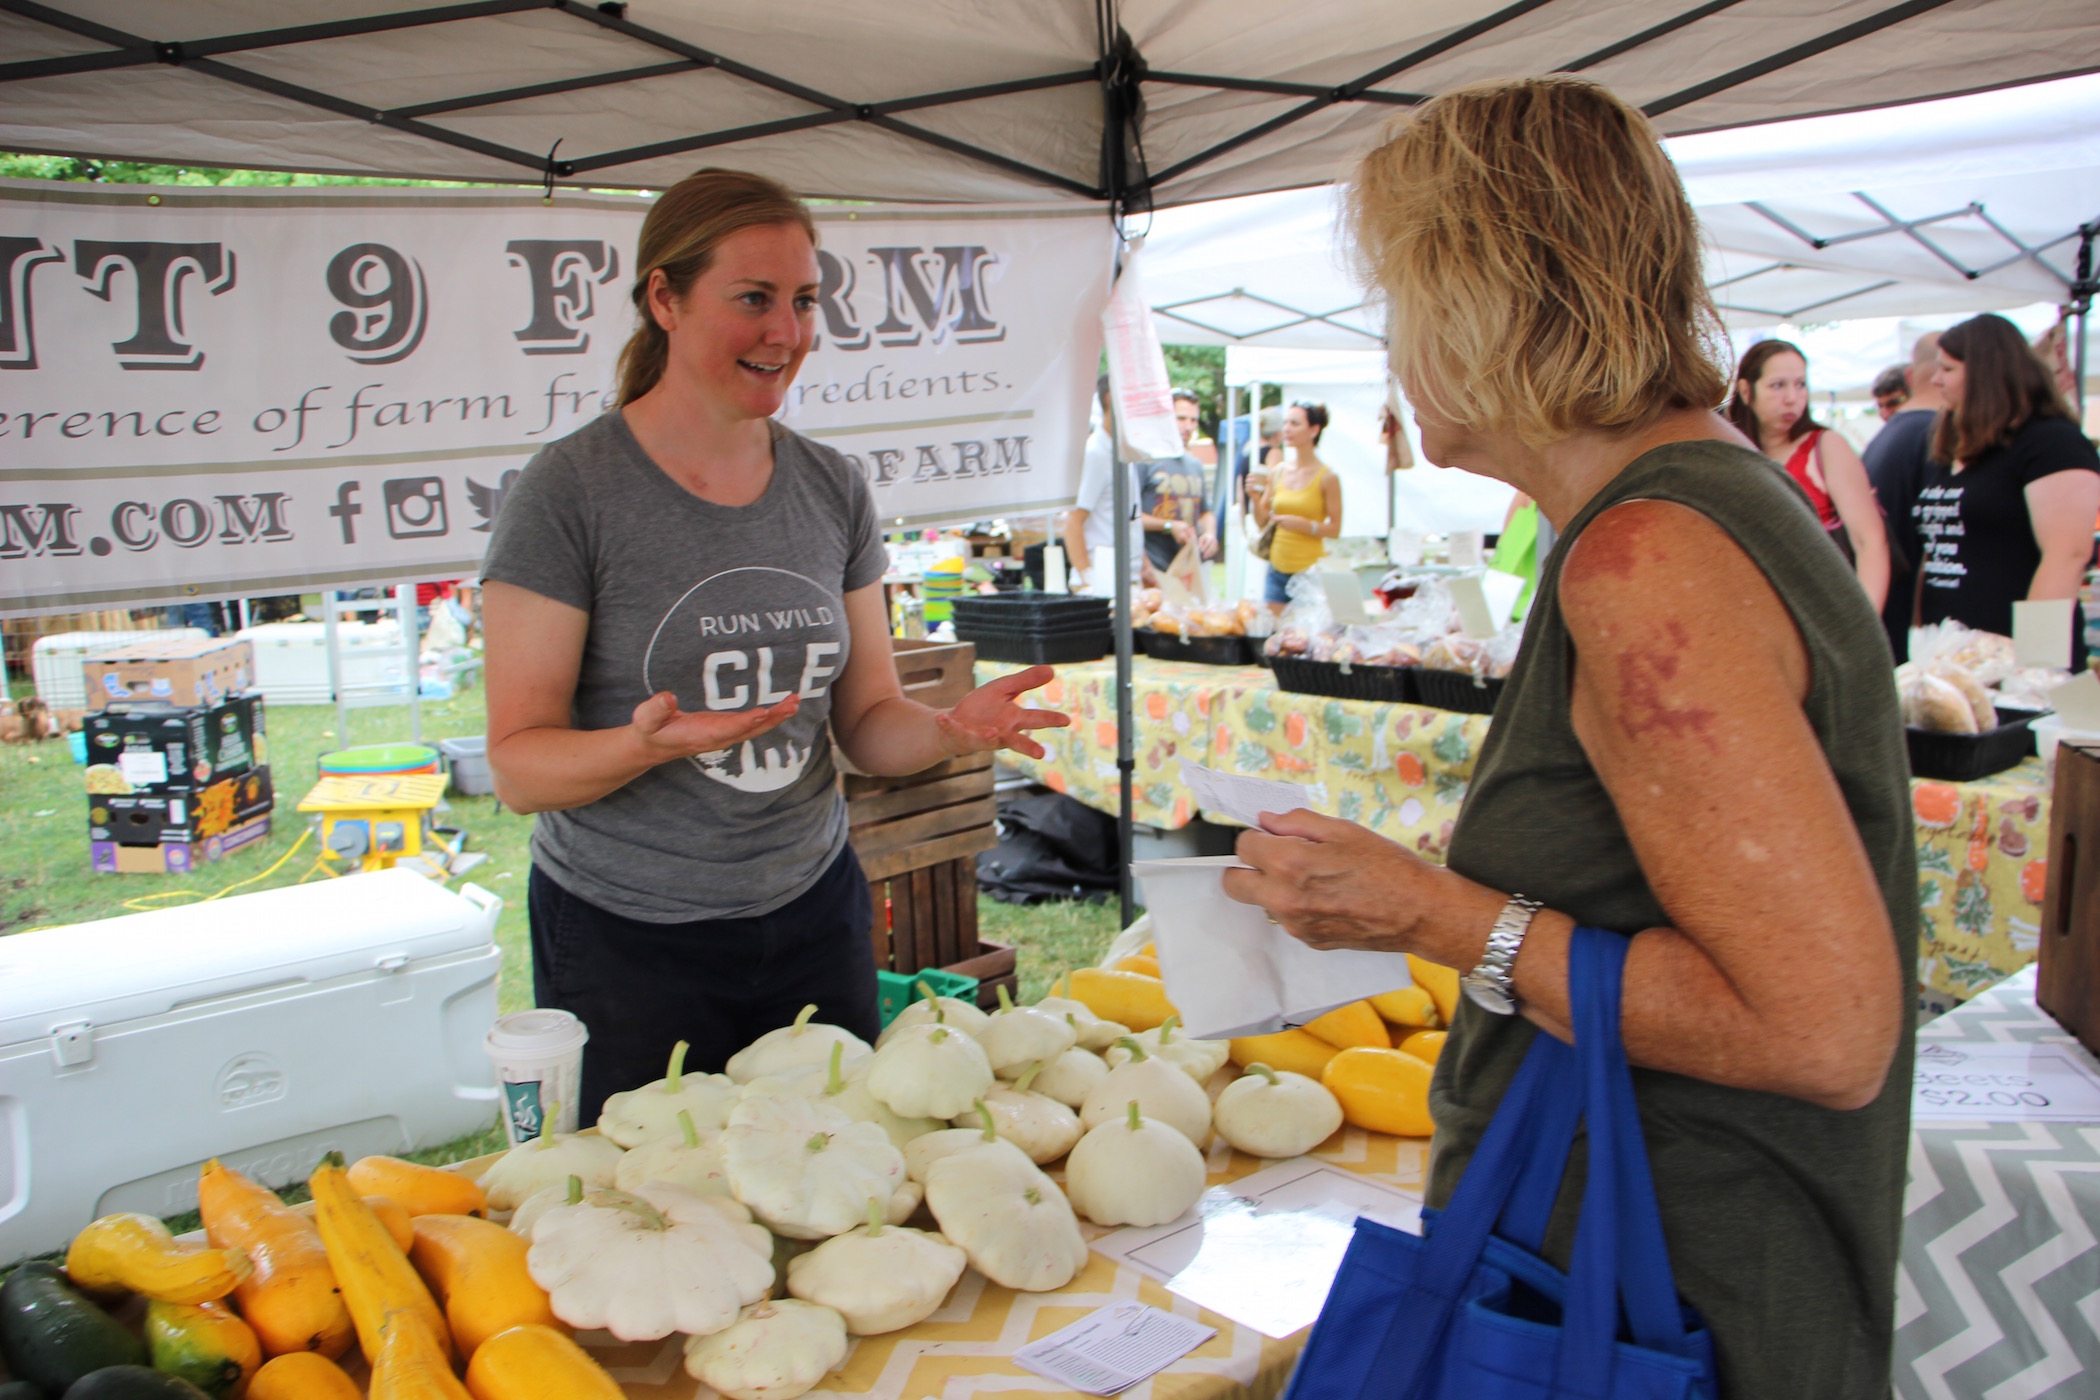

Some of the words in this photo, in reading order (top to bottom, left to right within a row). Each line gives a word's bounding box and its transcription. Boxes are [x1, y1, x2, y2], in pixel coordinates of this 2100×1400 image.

[326, 242, 429, 365] 9
[505, 239, 1006, 356] FRM
[0, 409, 222, 440] rence
[253, 385, 333, 452] of
[326, 382, 518, 450] farm
[700, 613, 761, 637] RUN
[765, 606, 835, 630] WILD
[702, 641, 841, 711] CLE
[1920, 1089, 2050, 1108] $2.00
